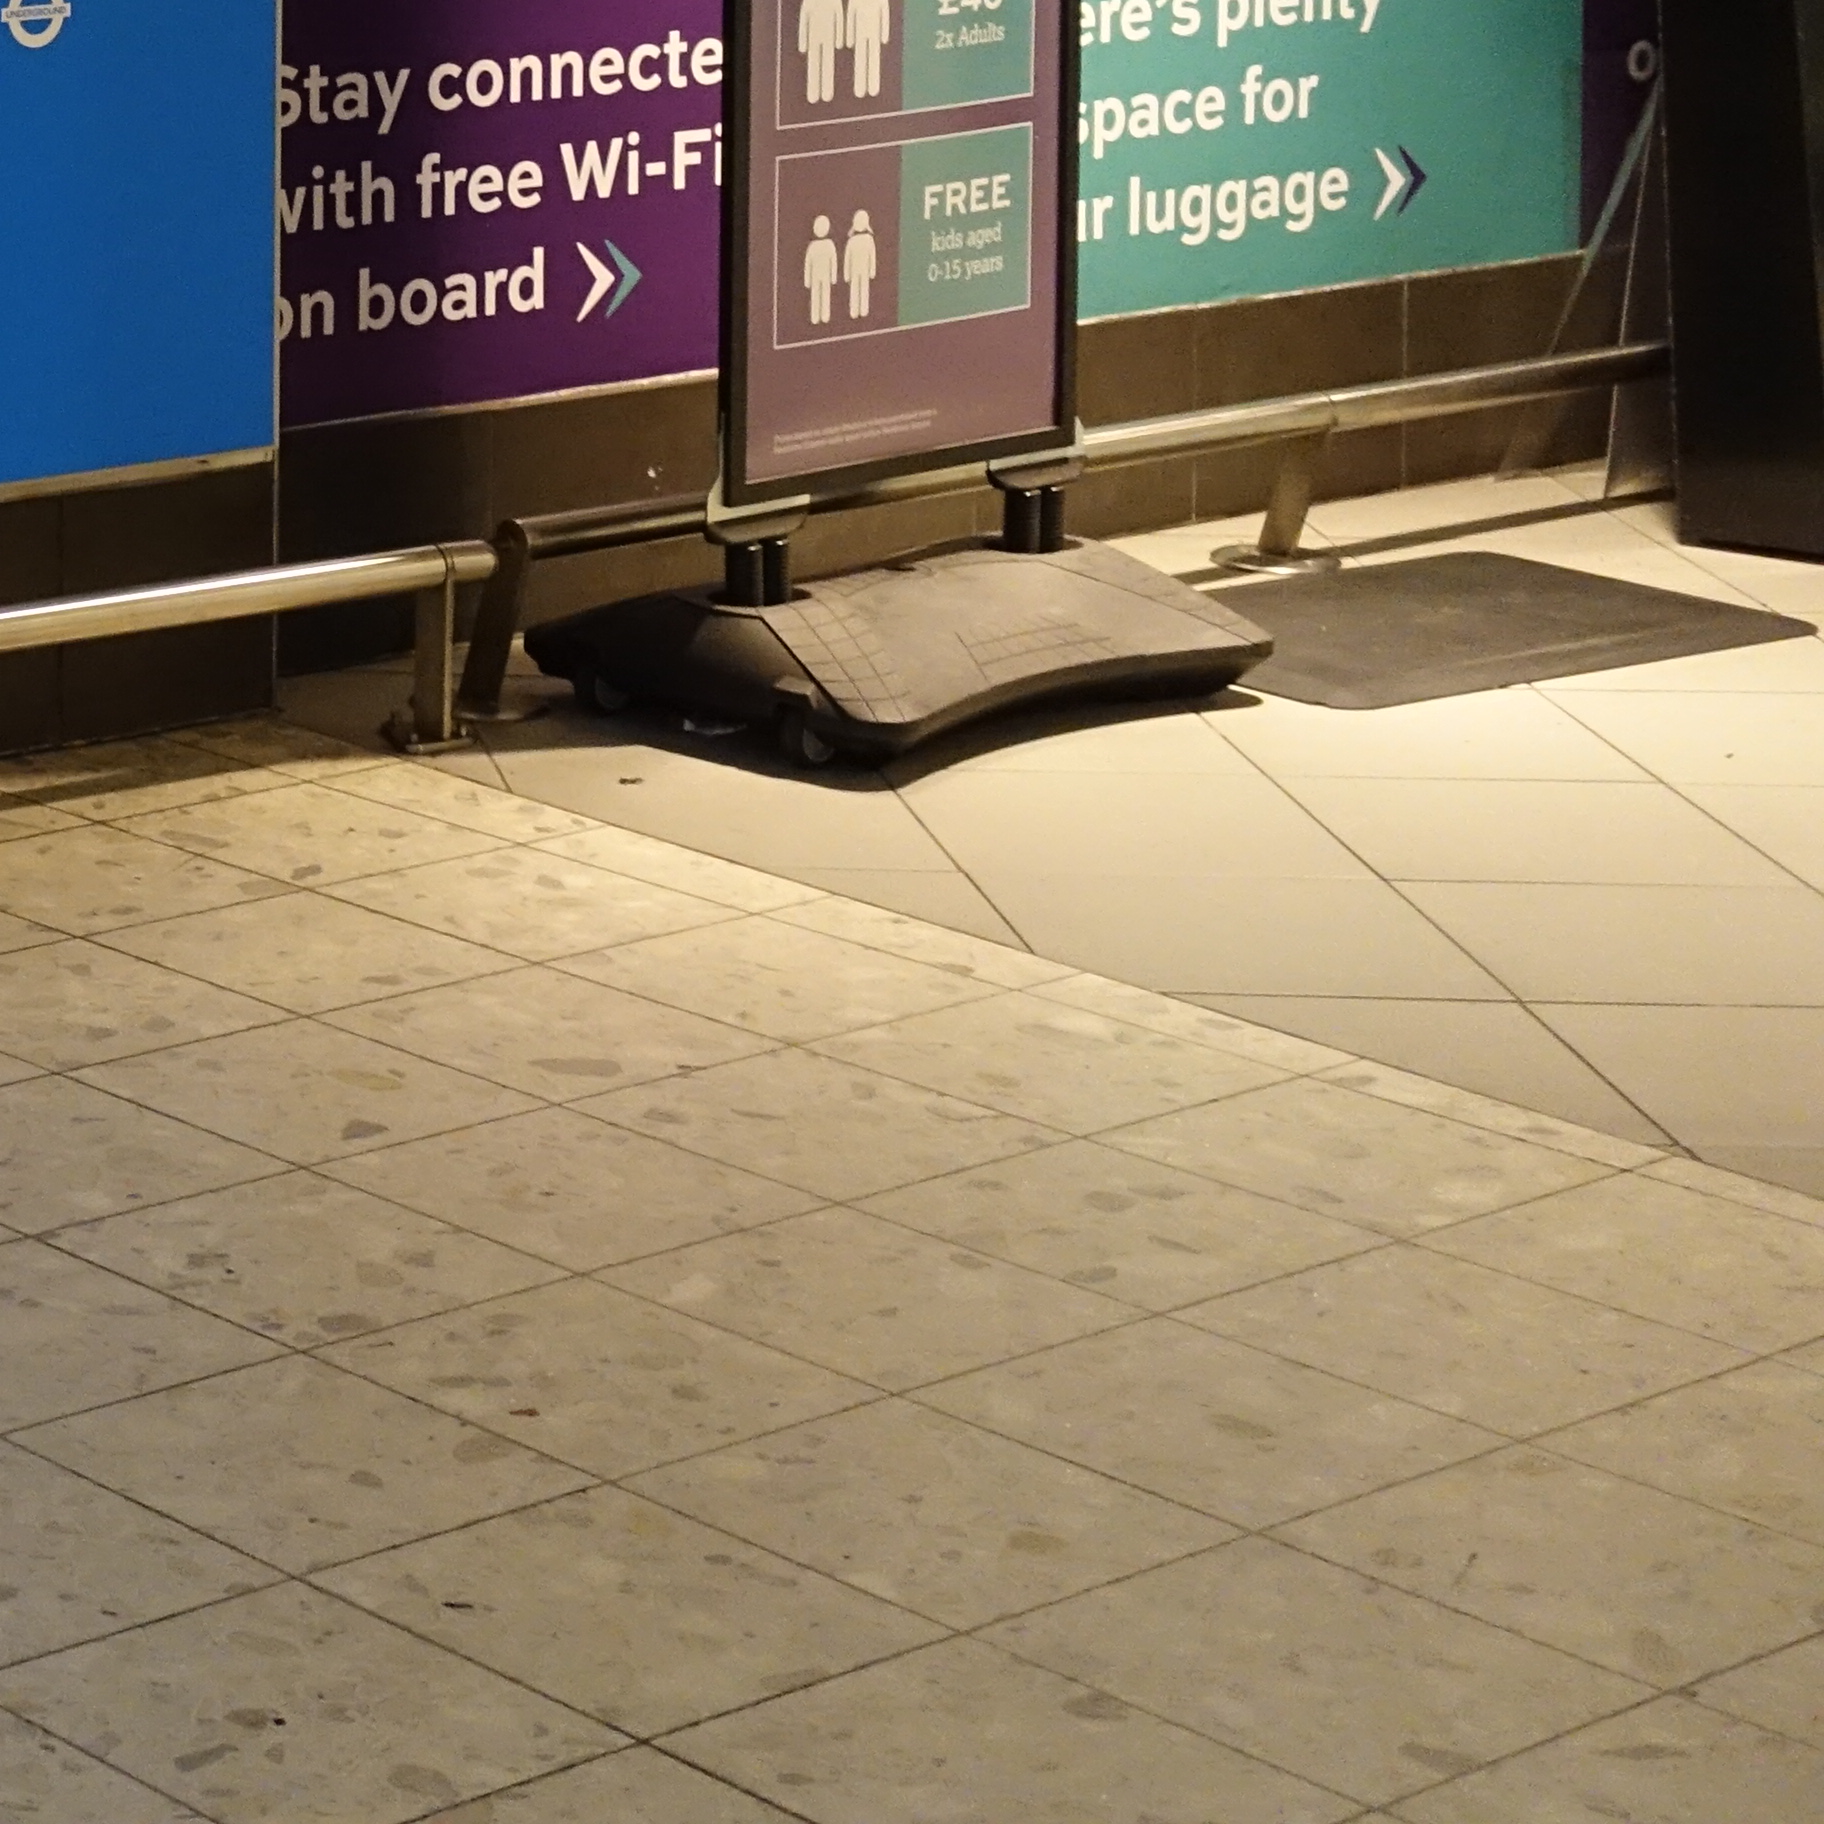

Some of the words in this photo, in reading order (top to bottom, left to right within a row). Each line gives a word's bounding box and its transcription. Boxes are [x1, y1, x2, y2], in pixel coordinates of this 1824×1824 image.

[935, 30, 954, 49] 2x
[957, 22, 1005, 47] Adults
[277, 62, 410, 135] Stay
[427, 31, 723, 111] connecte
[1240, 65, 1319, 125] for
[415, 152, 544, 217] free
[559, 122, 722, 202] Wi-Fi
[924, 174, 1010, 219] FREE
[931, 227, 964, 251] kids
[968, 222, 1003, 247] aged
[1128, 166, 1349, 247] luggage
[358, 246, 544, 331] board
[963, 251, 1004, 279] years
